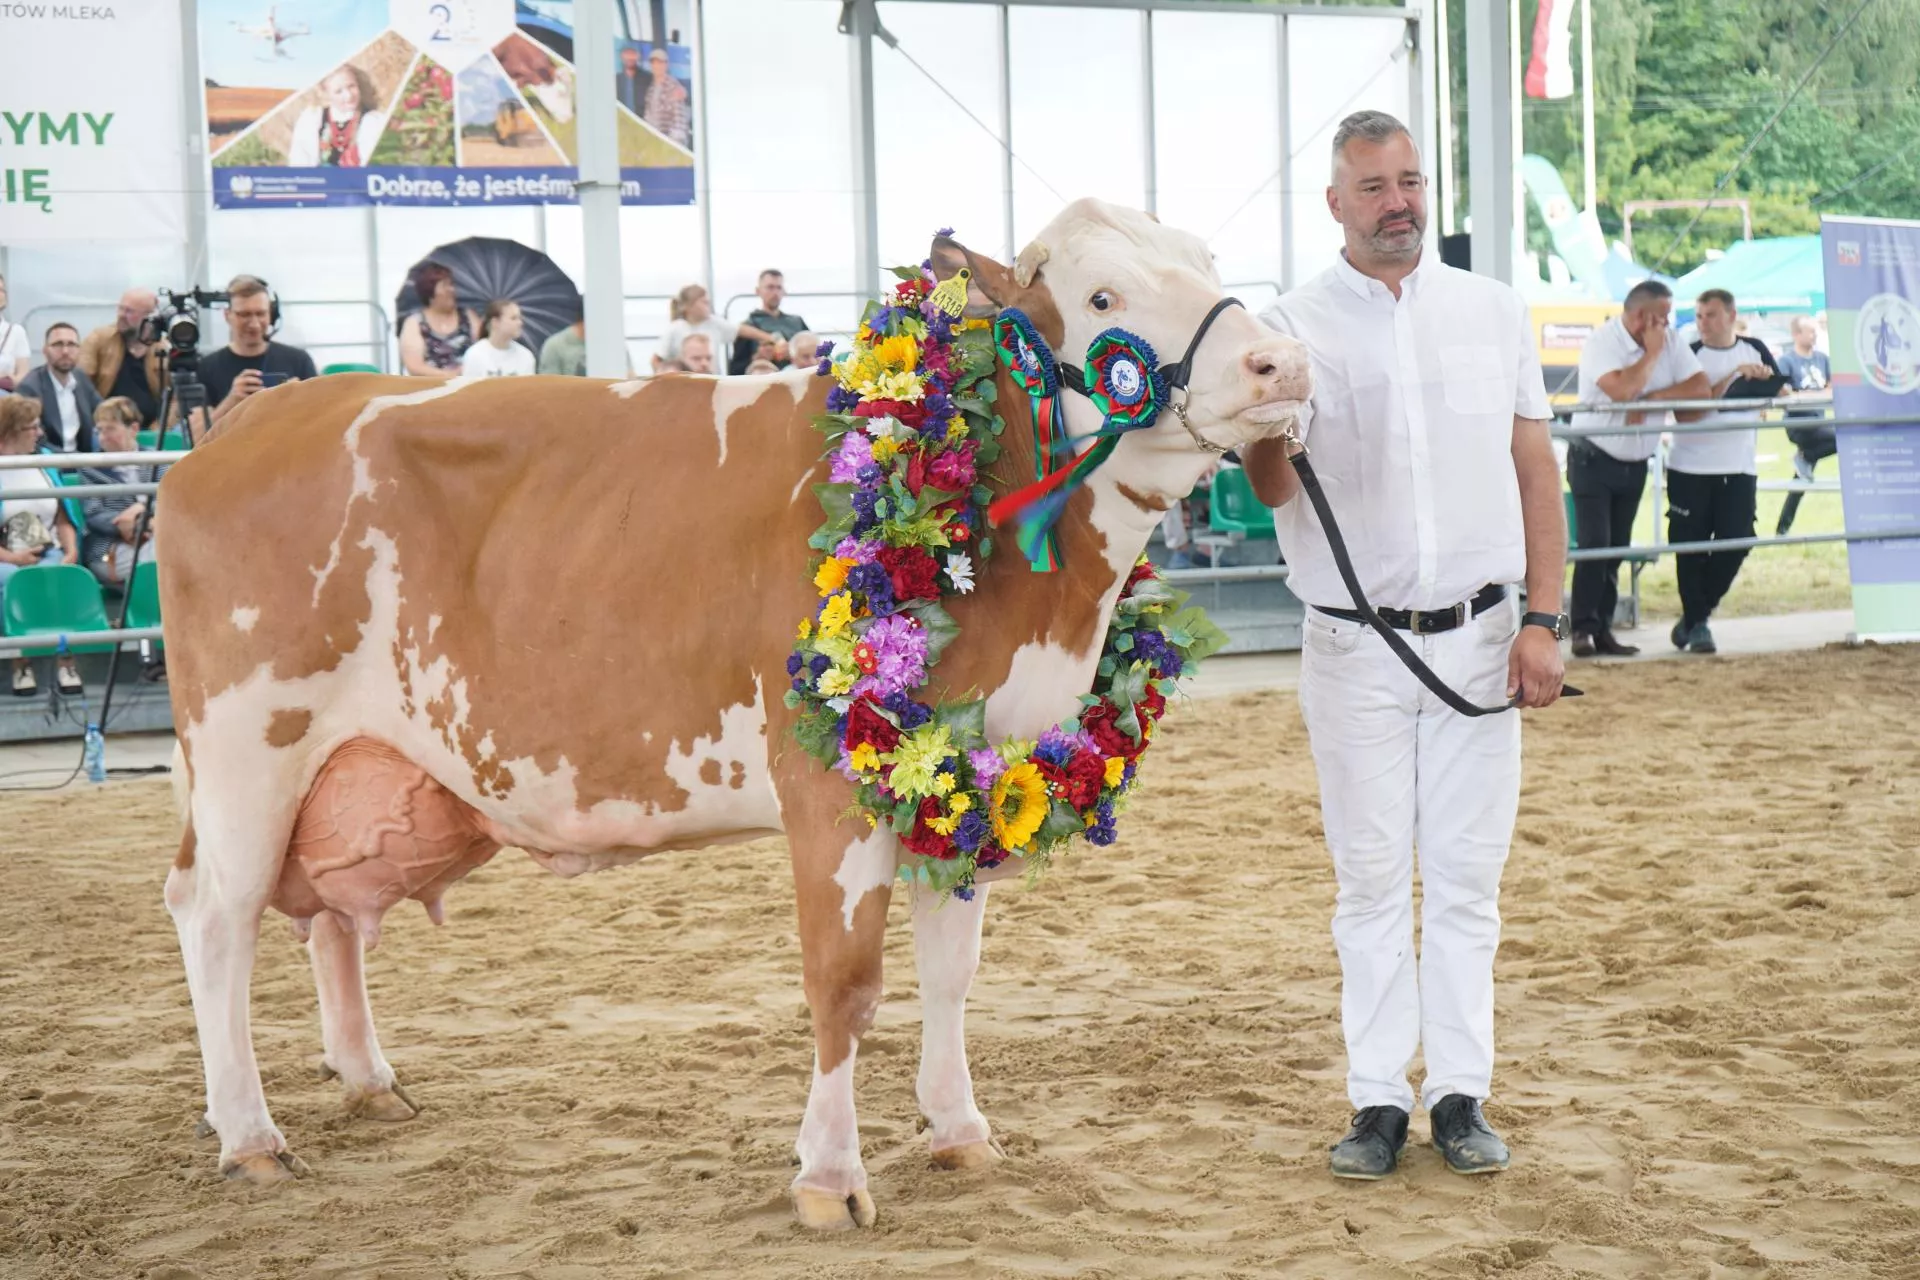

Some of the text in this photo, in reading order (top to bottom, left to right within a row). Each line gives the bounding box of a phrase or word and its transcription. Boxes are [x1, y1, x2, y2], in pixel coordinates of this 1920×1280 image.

[0, 1, 116, 20] TÓW MLEKA
[0, 111, 114, 145] YMY
[0, 169, 53, 213] IĘ
[367, 174, 451, 200] Dobrze,
[454, 174, 481, 197] że
[933, 290, 962, 316] 41318
